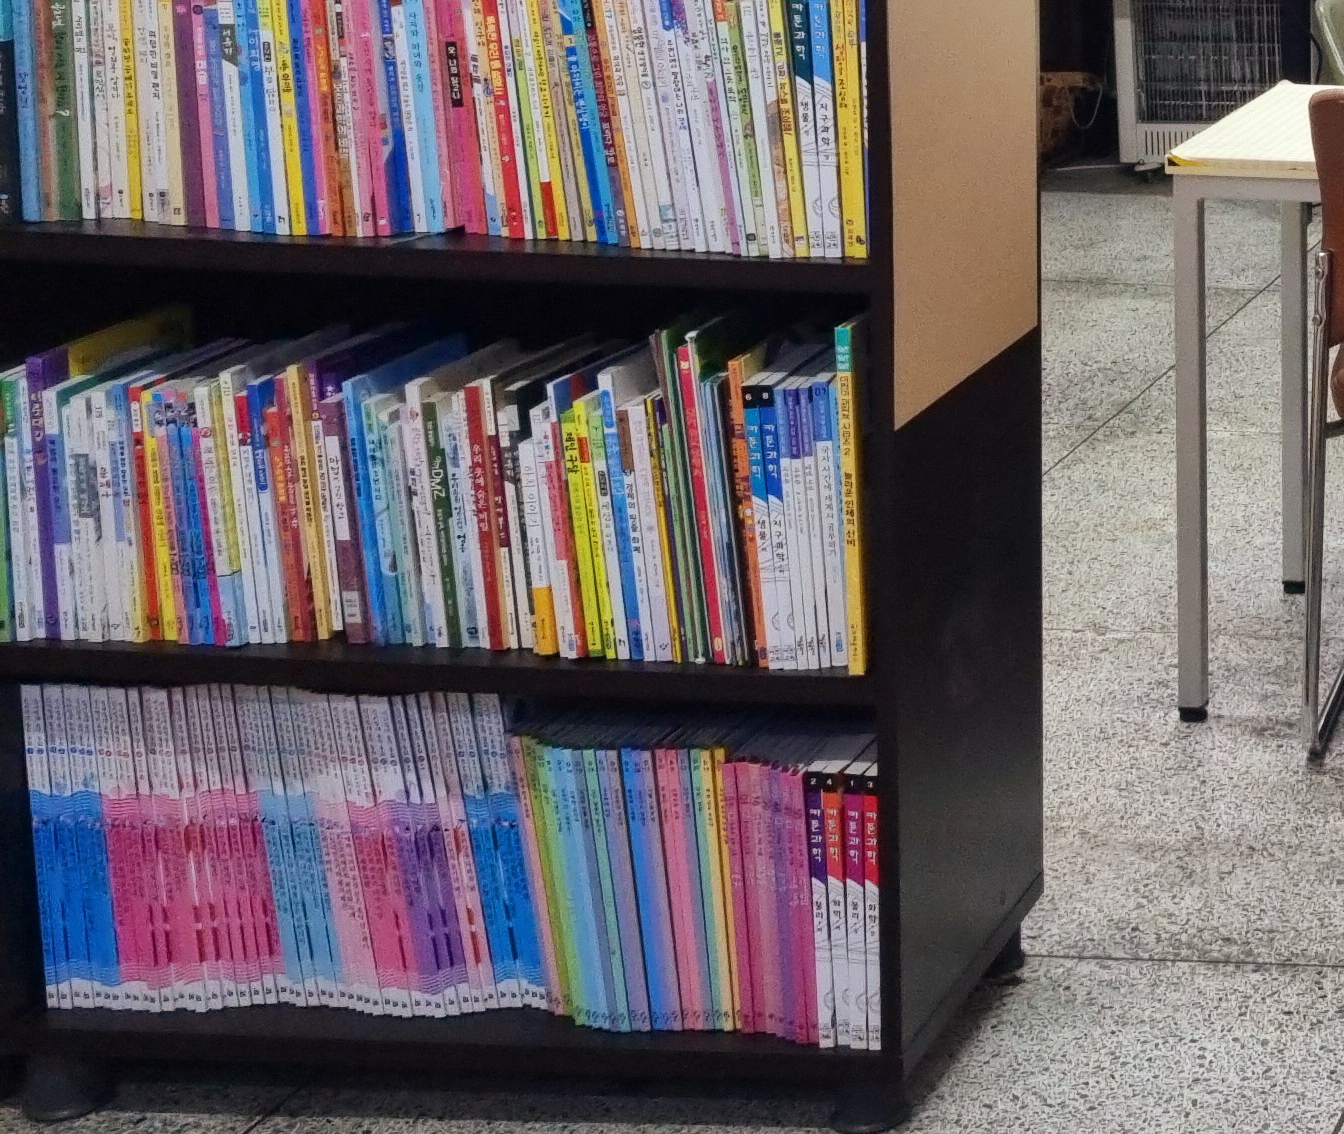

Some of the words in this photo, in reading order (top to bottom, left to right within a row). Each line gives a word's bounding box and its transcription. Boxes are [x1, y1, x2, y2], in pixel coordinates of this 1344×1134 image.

[745, 392, 752, 400] 6
[565, 430, 578, 451] 제인
[566, 453, 579, 474] 구달
[826, 778, 833, 786] 4
